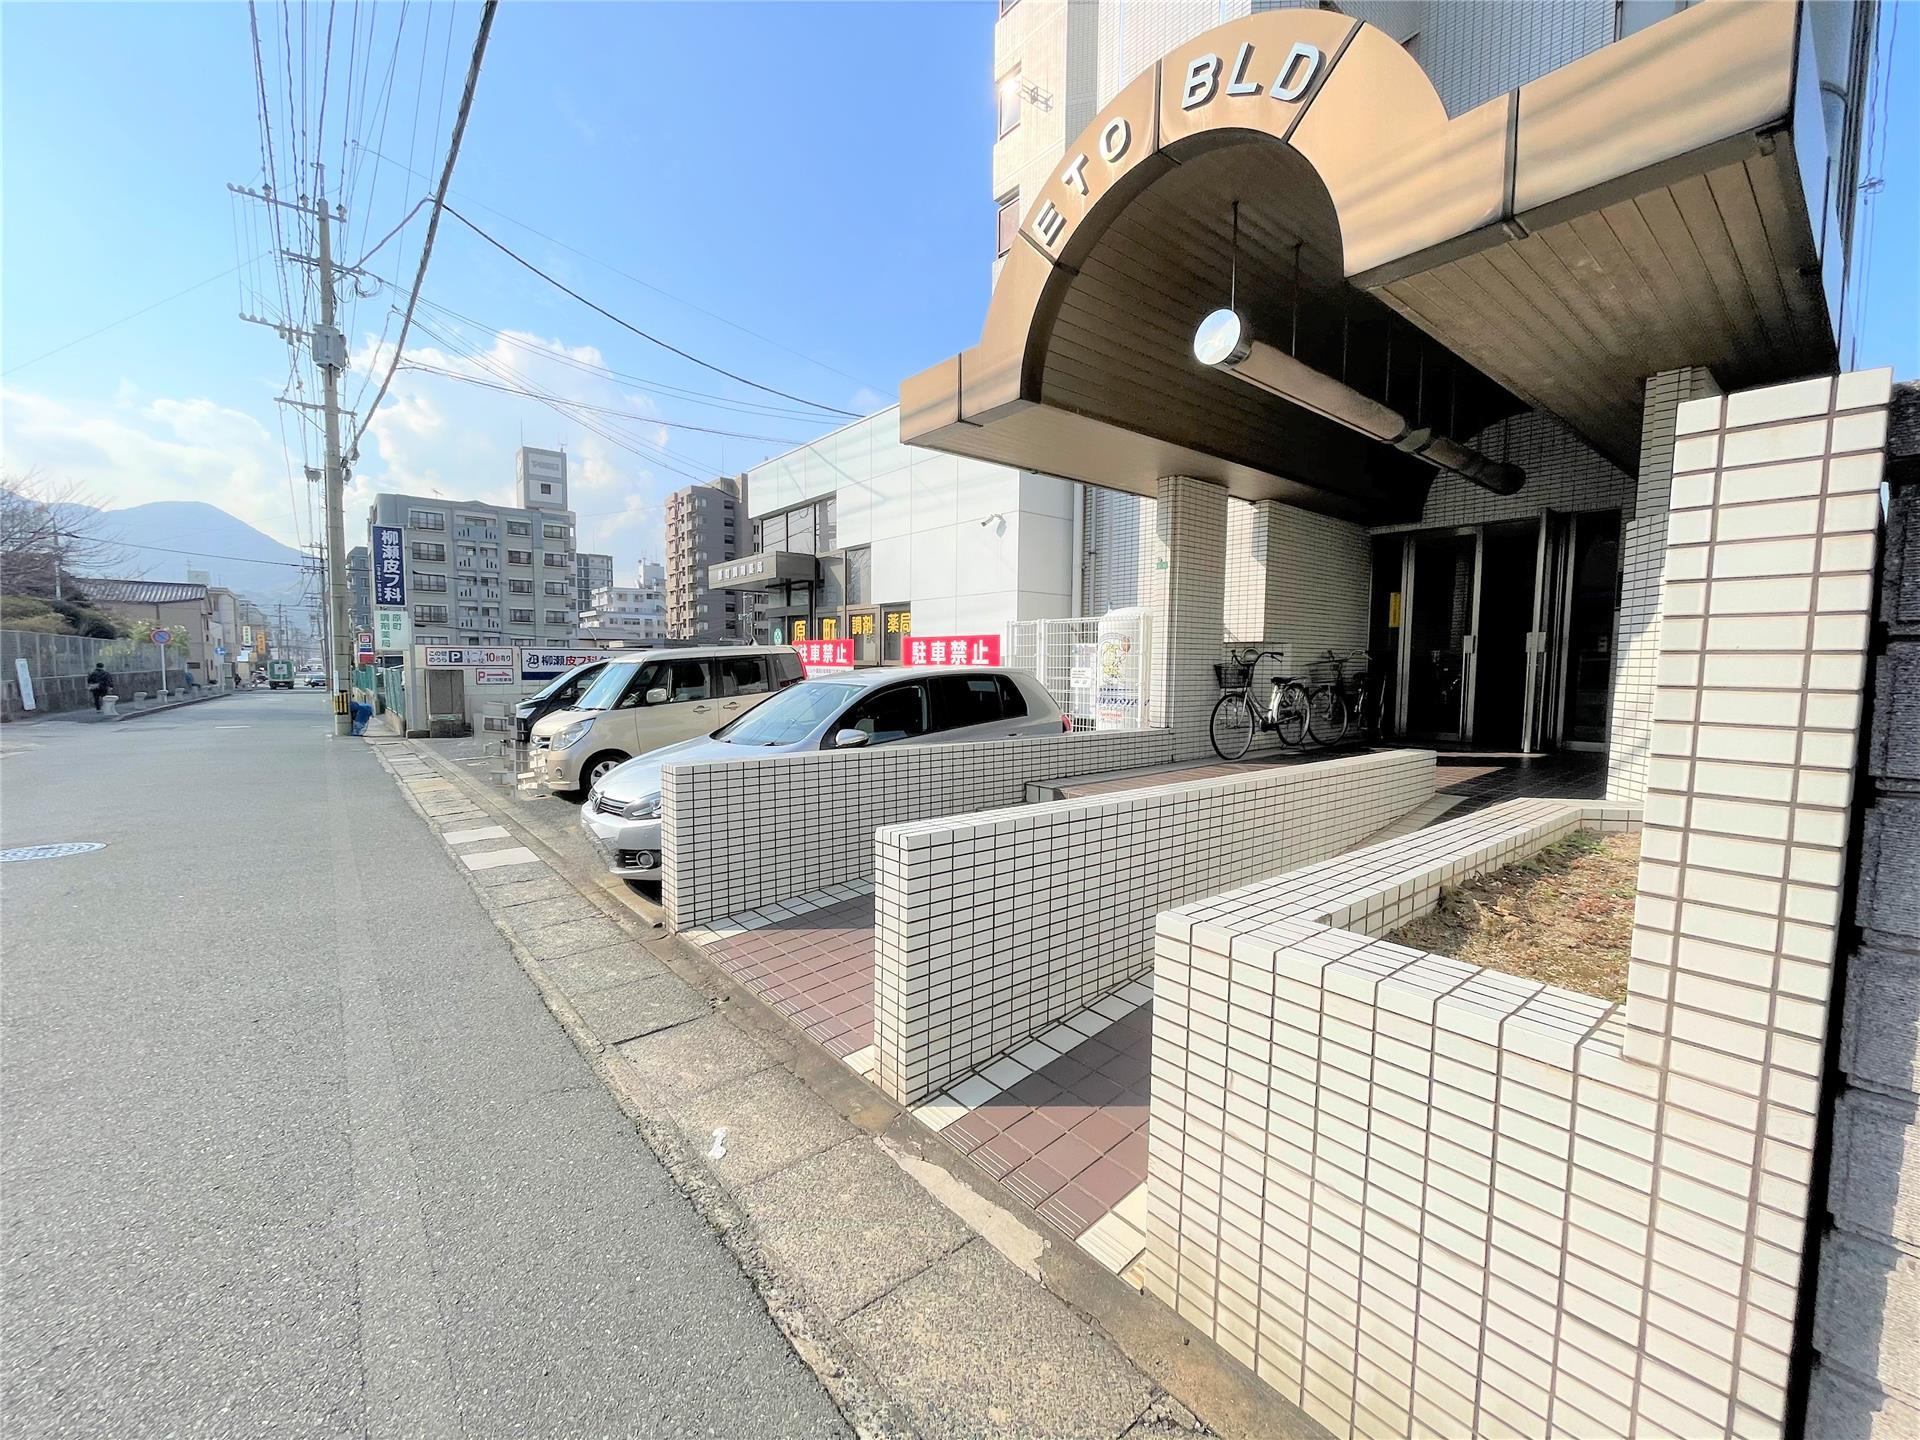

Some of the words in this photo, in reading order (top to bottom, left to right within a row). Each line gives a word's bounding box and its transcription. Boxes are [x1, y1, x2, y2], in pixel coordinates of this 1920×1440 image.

[1032, 115, 1132, 248] ETO
[1181, 41, 1328, 112] BLD
[381, 529, 402, 603] 柳瀬皮フ科
[911, 639, 990, 666] 駐車禁止
